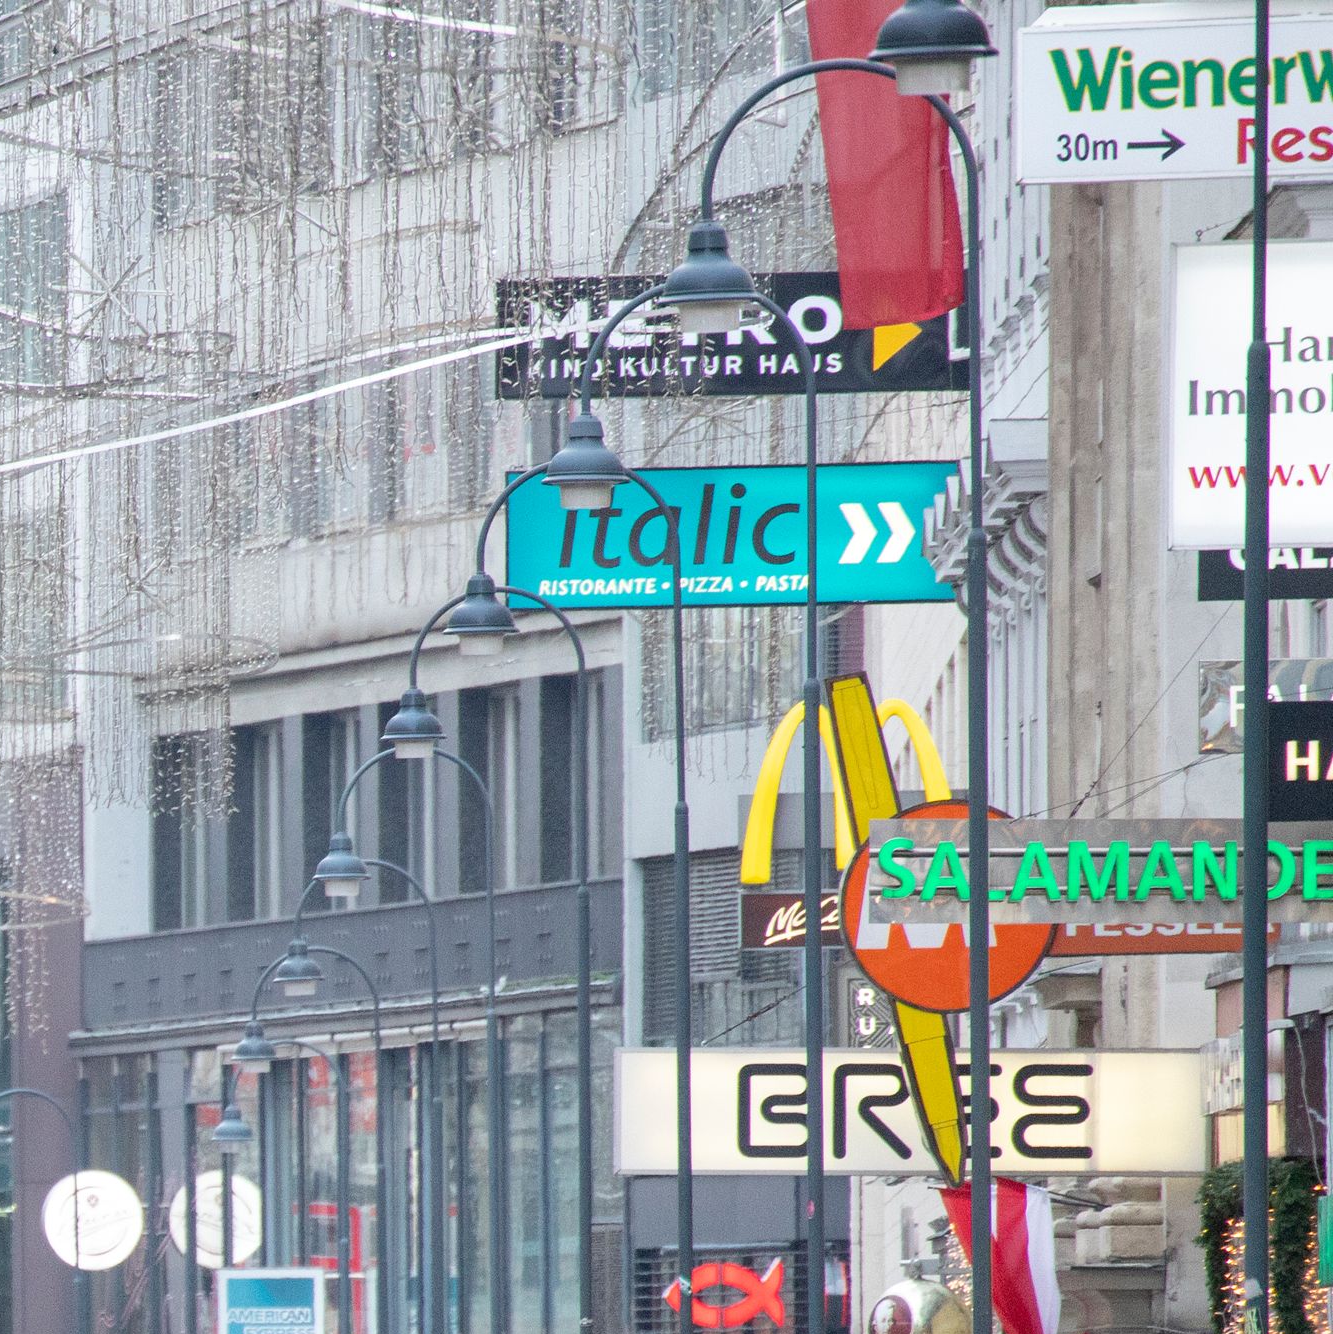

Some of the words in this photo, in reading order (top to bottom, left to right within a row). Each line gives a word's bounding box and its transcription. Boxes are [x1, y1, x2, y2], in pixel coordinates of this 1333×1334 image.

[1056, 133, 1118, 162] 30m
[1264, 326, 1333, 362] Ha
[619, 354, 743, 378] KULTUR
[1188, 373, 1333, 416] Immo
[1188, 463, 1333, 489] www.v
[559, 482, 800, 570] italic
[539, 577, 658, 596] RISTORANTE
[678, 575, 734, 594] PIZZA
[754, 574, 809, 592] PASTA
[1286, 740, 1333, 782] H
[877, 836, 1333, 903] SAAMANDE
[228, 1309, 310, 1324] AMERICAN
